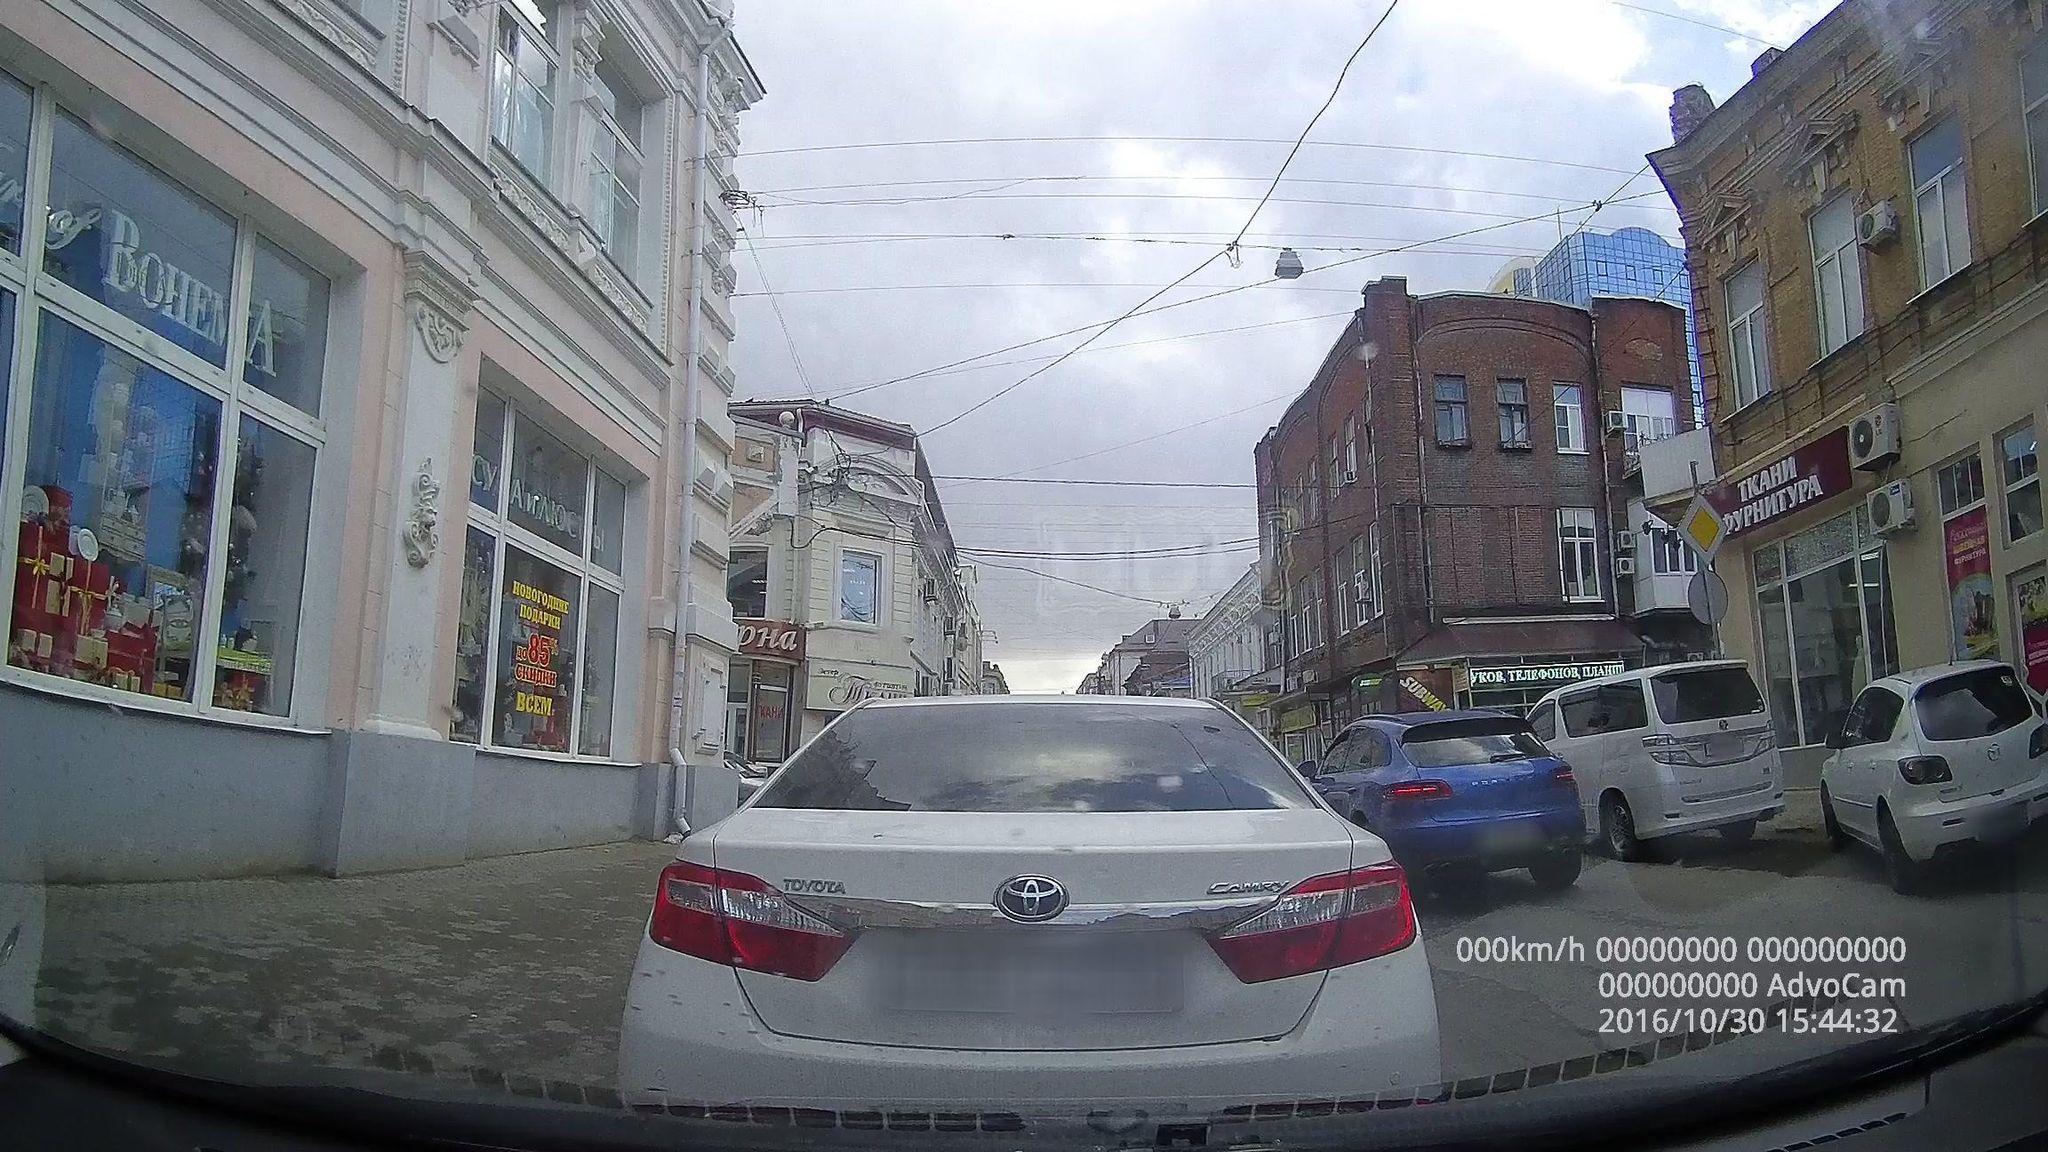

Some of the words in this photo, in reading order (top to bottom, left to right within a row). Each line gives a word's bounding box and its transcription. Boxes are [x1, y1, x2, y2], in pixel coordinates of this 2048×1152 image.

[101, 208, 277, 378] BOHEMA
[1738, 456, 1797, 502] ТКАНИ
[512, 580, 569, 614] НОВОГОДНИЕ
[519, 603, 561, 630] ПОДАРКИ
[515, 663, 557, 688] СКИДКИ
[516, 691, 553, 717] ВСЕМ
[783, 878, 847, 895] TOYOTA
